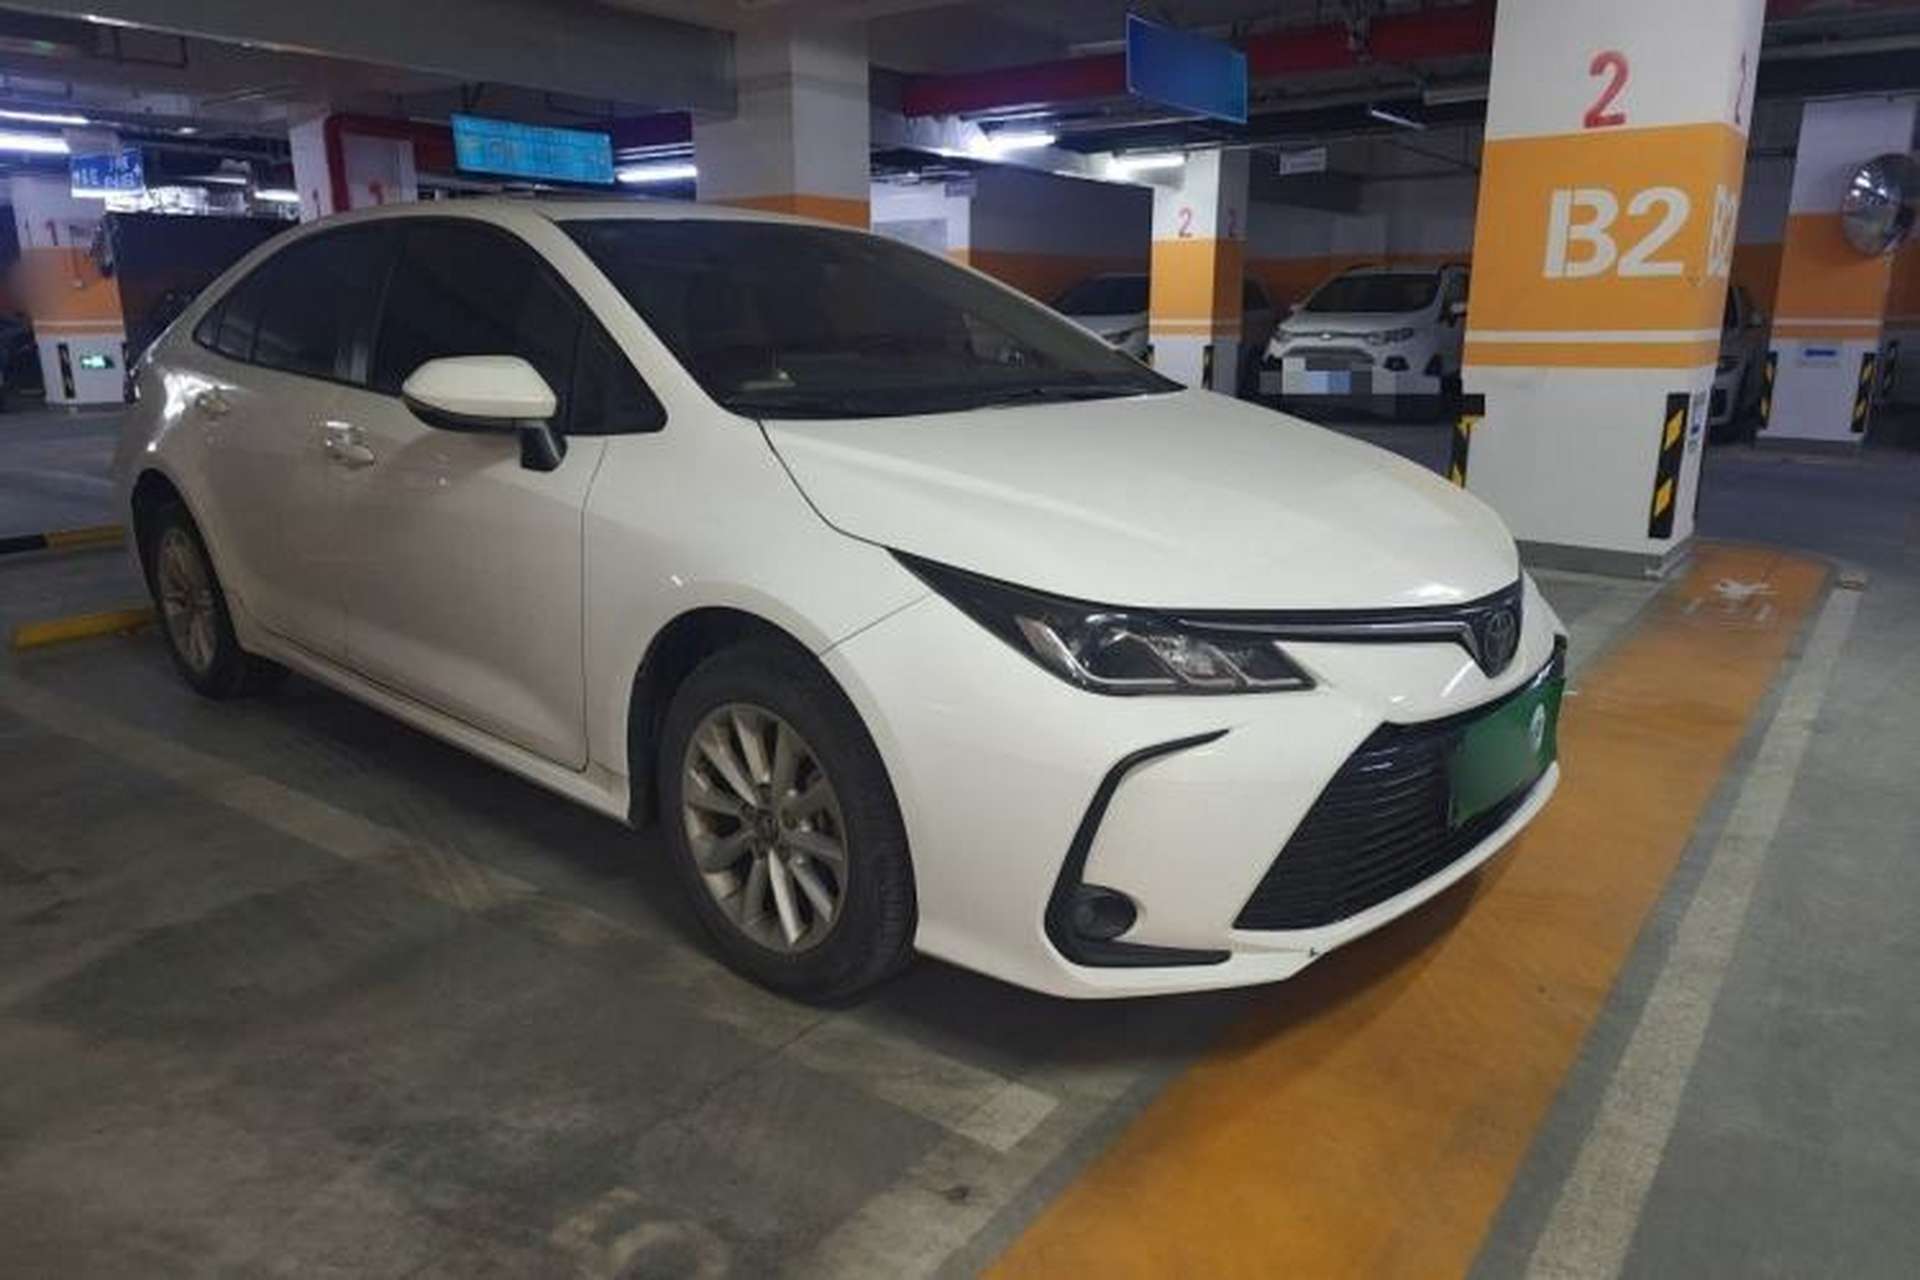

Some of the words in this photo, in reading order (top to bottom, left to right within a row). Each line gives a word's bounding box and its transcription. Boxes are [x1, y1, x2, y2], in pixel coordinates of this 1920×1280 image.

[1583, 51, 1629, 128] 2
[1179, 206, 1192, 238] 2
[1544, 187, 1691, 278] B2
